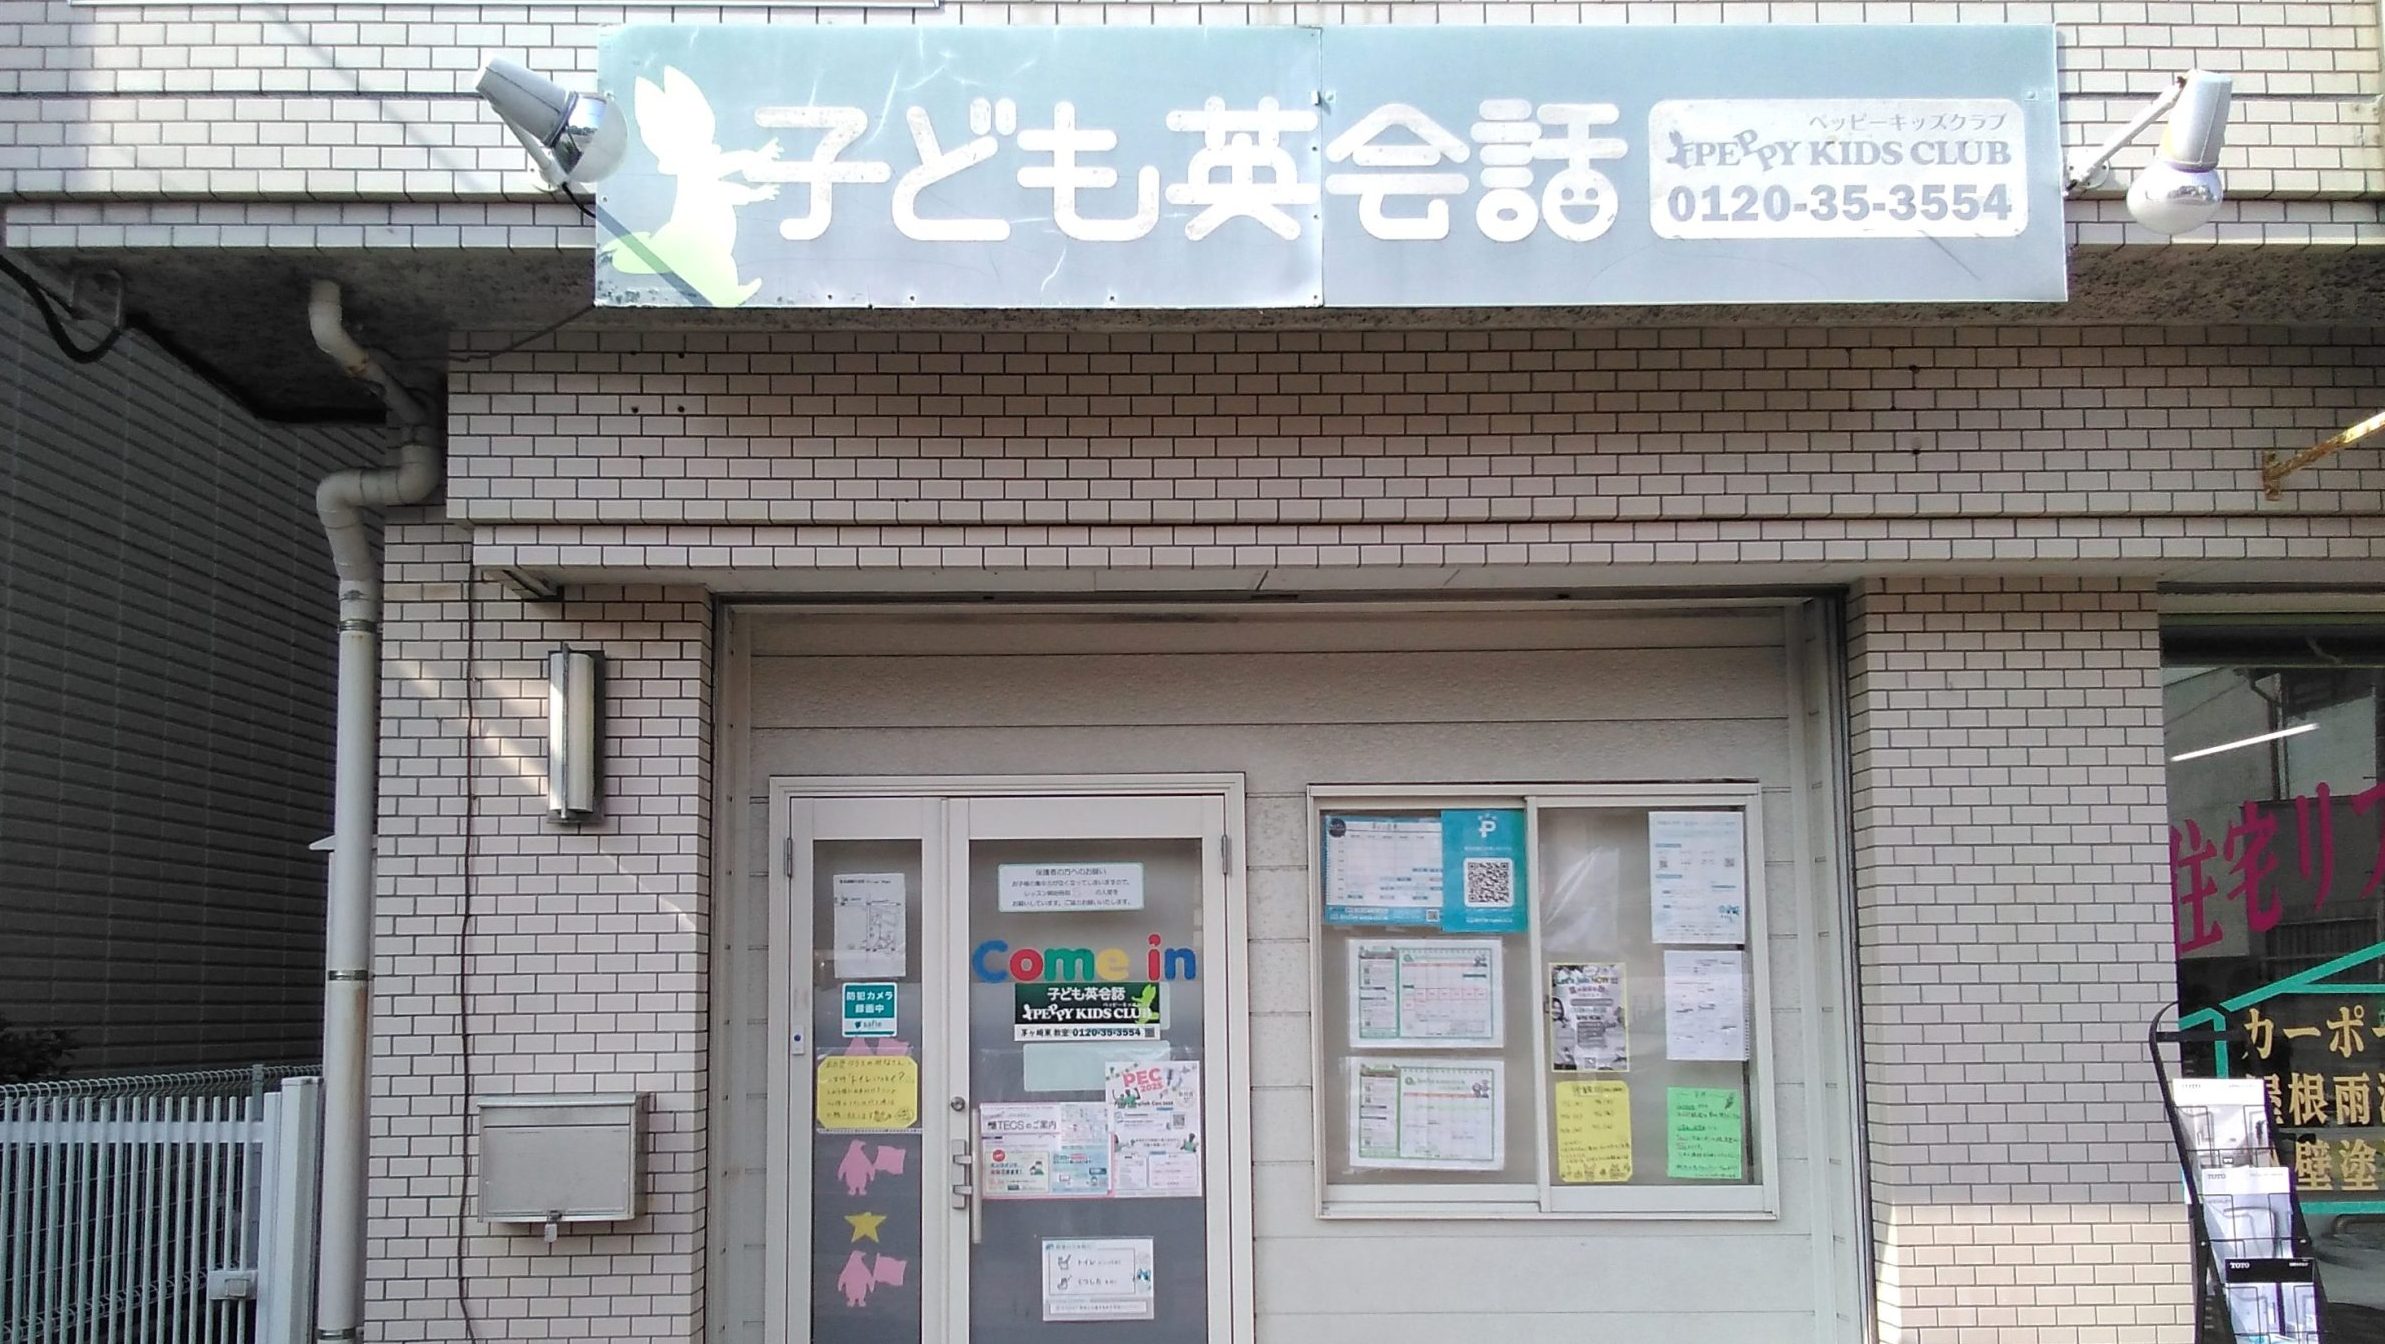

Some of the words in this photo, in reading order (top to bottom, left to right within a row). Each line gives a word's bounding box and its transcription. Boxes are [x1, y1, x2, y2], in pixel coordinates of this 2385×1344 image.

[1692, 129, 1802, 173] PEPPY
[1809, 140, 1905, 167] KIDS
[1910, 140, 2013, 167] CLUB
[743, 95, 1628, 242] 子ども英会話
[1666, 183, 2013, 223] 0120-35-3554
[972, 939, 1130, 984] Come
[1147, 933, 1197, 981] in
[846, 991, 893, 1001] 防犯カメラ
[1047, 986, 1126, 1002] 子ども英会話
[855, 1003, 885, 1014] 録画中
[1032, 1003, 1075, 1022] PEPPY
[1076, 1007, 1112, 1020] KIDS
[1123, 1067, 1162, 1087] PEC
